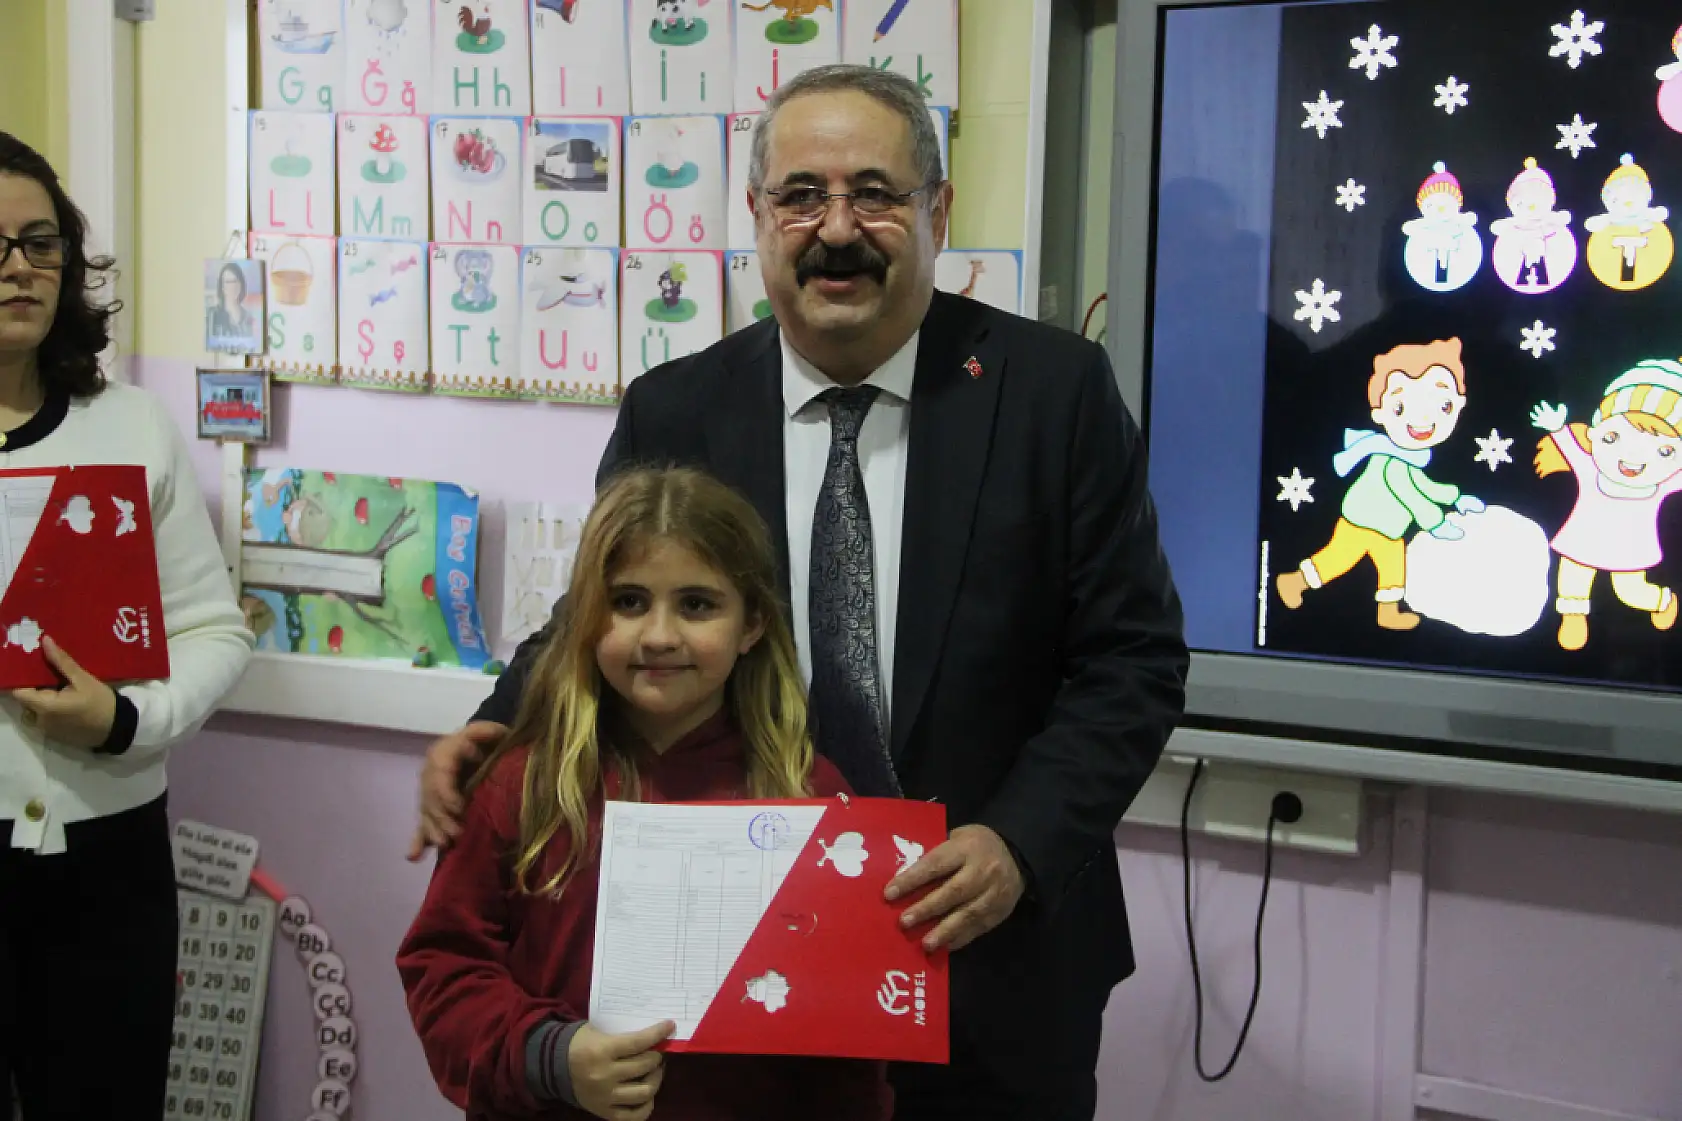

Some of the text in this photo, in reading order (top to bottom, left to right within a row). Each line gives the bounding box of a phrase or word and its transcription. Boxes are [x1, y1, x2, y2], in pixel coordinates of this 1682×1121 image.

[216, 909, 228, 928] 9
[241, 912, 259, 930] 10
[281, 907, 306, 927] Aa
[235, 943, 255, 962] 20
[299, 932, 324, 954] Bb
[914, 970, 926, 1026] MODEL
[225, 1007, 245, 1024] 40
[321, 1026, 352, 1045] Dd
[326, 1059, 352, 1077] Ee
[216, 1069, 237, 1088] 60
